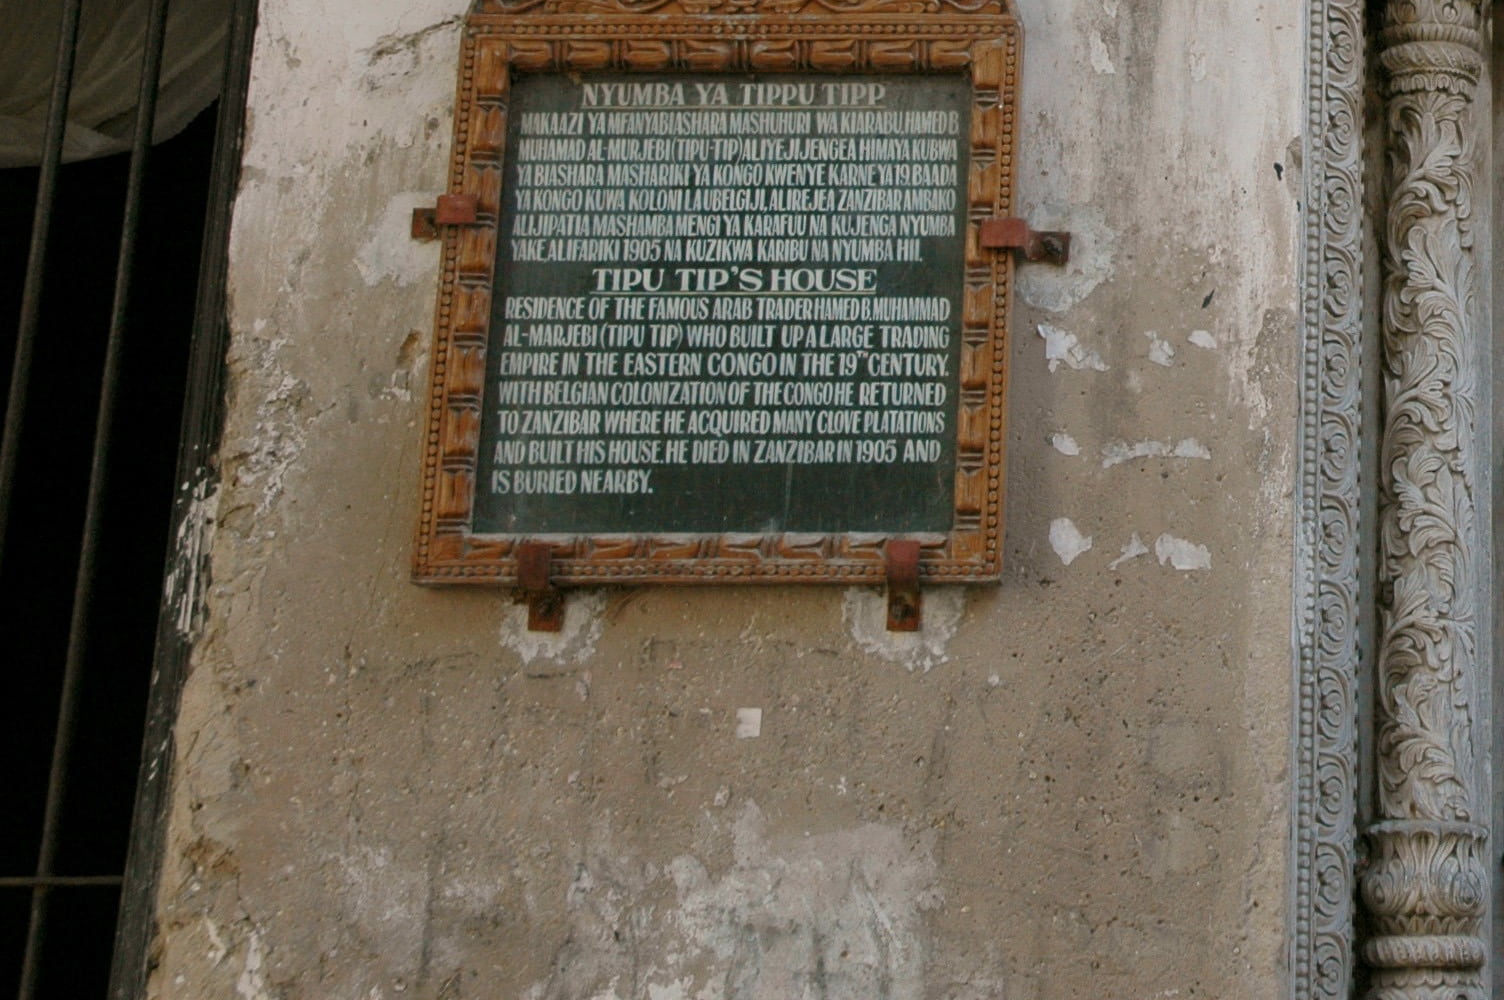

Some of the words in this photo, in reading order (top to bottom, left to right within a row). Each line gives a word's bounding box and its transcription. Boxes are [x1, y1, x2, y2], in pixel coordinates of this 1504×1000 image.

[582, 83, 685, 106] NYUMBA
[695, 83, 730, 106] YA
[740, 83, 816, 106] TIPPU
[821, 83, 886, 106] TIPP
[520, 111, 584, 135] MAKAAZI
[588, 111, 606, 135] YA
[607, 111, 727, 135] MFANYABIASHARA
[729, 111, 811, 135] MASHUHURI
[816, 111, 838, 135] WA
[518, 138, 585, 161] MUHAMAD
[587, 138, 671, 161] AL-MURJEBI
[859, 138, 910, 161] HIMAYA
[912, 138, 958, 161] KUBWA
[517, 163, 532, 187] YA
[534, 163, 604, 187] BIASHARA
[606, 163, 689, 187] MASHARIKI
[692, 163, 710, 187] YA
[713, 163, 763, 187] KONGO
[764, 163, 826, 187] KWENYE
[828, 163, 876, 187] KARNE
[877, 163, 894, 187] YA
[515, 188, 531, 211] YA
[532, 188, 582, 211] KONGO
[585, 188, 625, 211] KUWA
[628, 188, 683, 211] KOLONI
[685, 188, 701, 211] LA
[838, 188, 901, 211] ZANZIBAR
[903, 188, 956, 211] AMBAKO
[512, 214, 590, 237] ALIJIPATIA
[592, 214, 673, 237] MASHAMBA
[675, 214, 721, 237] MENGI
[723, 214, 740, 237] YA
[743, 214, 806, 237] KARAFUU
[809, 214, 827, 237] NA
[830, 214, 897, 237] KUJENGA
[899, 214, 956, 237] NYUMBA
[623, 239, 661, 262] 1905
[664, 239, 681, 262] NA
[685, 239, 753, 262] KUZIKWA
[757, 239, 808, 262] KARIBU
[811, 239, 829, 262] NA
[831, 239, 894, 262] NYUMBA
[896, 239, 923, 262] HII.
[592, 268, 664, 291] TIPU
[674, 266, 763, 291] TIP'S
[770, 268, 877, 291] HOUSE
[505, 297, 584, 320] RESIDENCE
[588, 297, 609, 320] OF
[614, 297, 646, 320] THE
[649, 297, 709, 320] FAMOUS
[712, 297, 752, 320] ARAB
[756, 297, 813, 320] TRADER
[813, 297, 859, 320] HAMED
[873, 297, 950, 320] MUHAMMAD
[504, 324, 599, 348] AL-MARJEBI
[601, 322, 645, 350] (TIPU
[650, 323, 683, 350] TIP)
[686, 324, 727, 348] WHO
[729, 324, 776, 348] BUILT
[781, 324, 804, 348] UP
[805, 324, 817, 348] A
[820, 324, 874, 348] LARGE
[879, 324, 950, 348] TRADING
[500, 352, 559, 376] EMPIRE
[561, 352, 580, 376] IN
[585, 352, 619, 376] THE
[623, 352, 702, 376] EASTERN
[707, 352, 777, 376] CONGO
[779, 352, 797, 376] IN
[801, 352, 835, 376] THE
[868, 352, 950, 376] CENTURY.
[499, 381, 542, 405] WITH
[543, 381, 609, 405] BELGIAN
[610, 381, 727, 405] COLONIZATION
[728, 381, 750, 405] OF
[753, 381, 783, 405] THE
[783, 381, 834, 405] CONGO
[834, 381, 854, 405] HE
[859, 381, 947, 405] RETURNED
[497, 409, 519, 434] TO
[521, 409, 600, 434] ZANZIBAR
[604, 409, 662, 434] WHERE
[664, 409, 686, 434] HE
[687, 409, 771, 437] ACQUIRED
[773, 409, 816, 434] MANY
[817, 409, 861, 434] CLOVE
[863, 409, 946, 434] PLATATIONS
[494, 439, 526, 464] AND
[528, 439, 575, 464] BUILT
[577, 439, 605, 464] HIS
[665, 439, 690, 464] HE
[692, 439, 729, 464] DIED
[732, 439, 750, 464] IN
[753, 439, 835, 464] ZANZIBAR
[837, 439, 853, 464] IN
[855, 439, 897, 464] 1905
[902, 439, 942, 464] AND
[492, 469, 511, 494] IS
[513, 469, 578, 494] BURIED
[580, 469, 654, 494] NEARBY.
